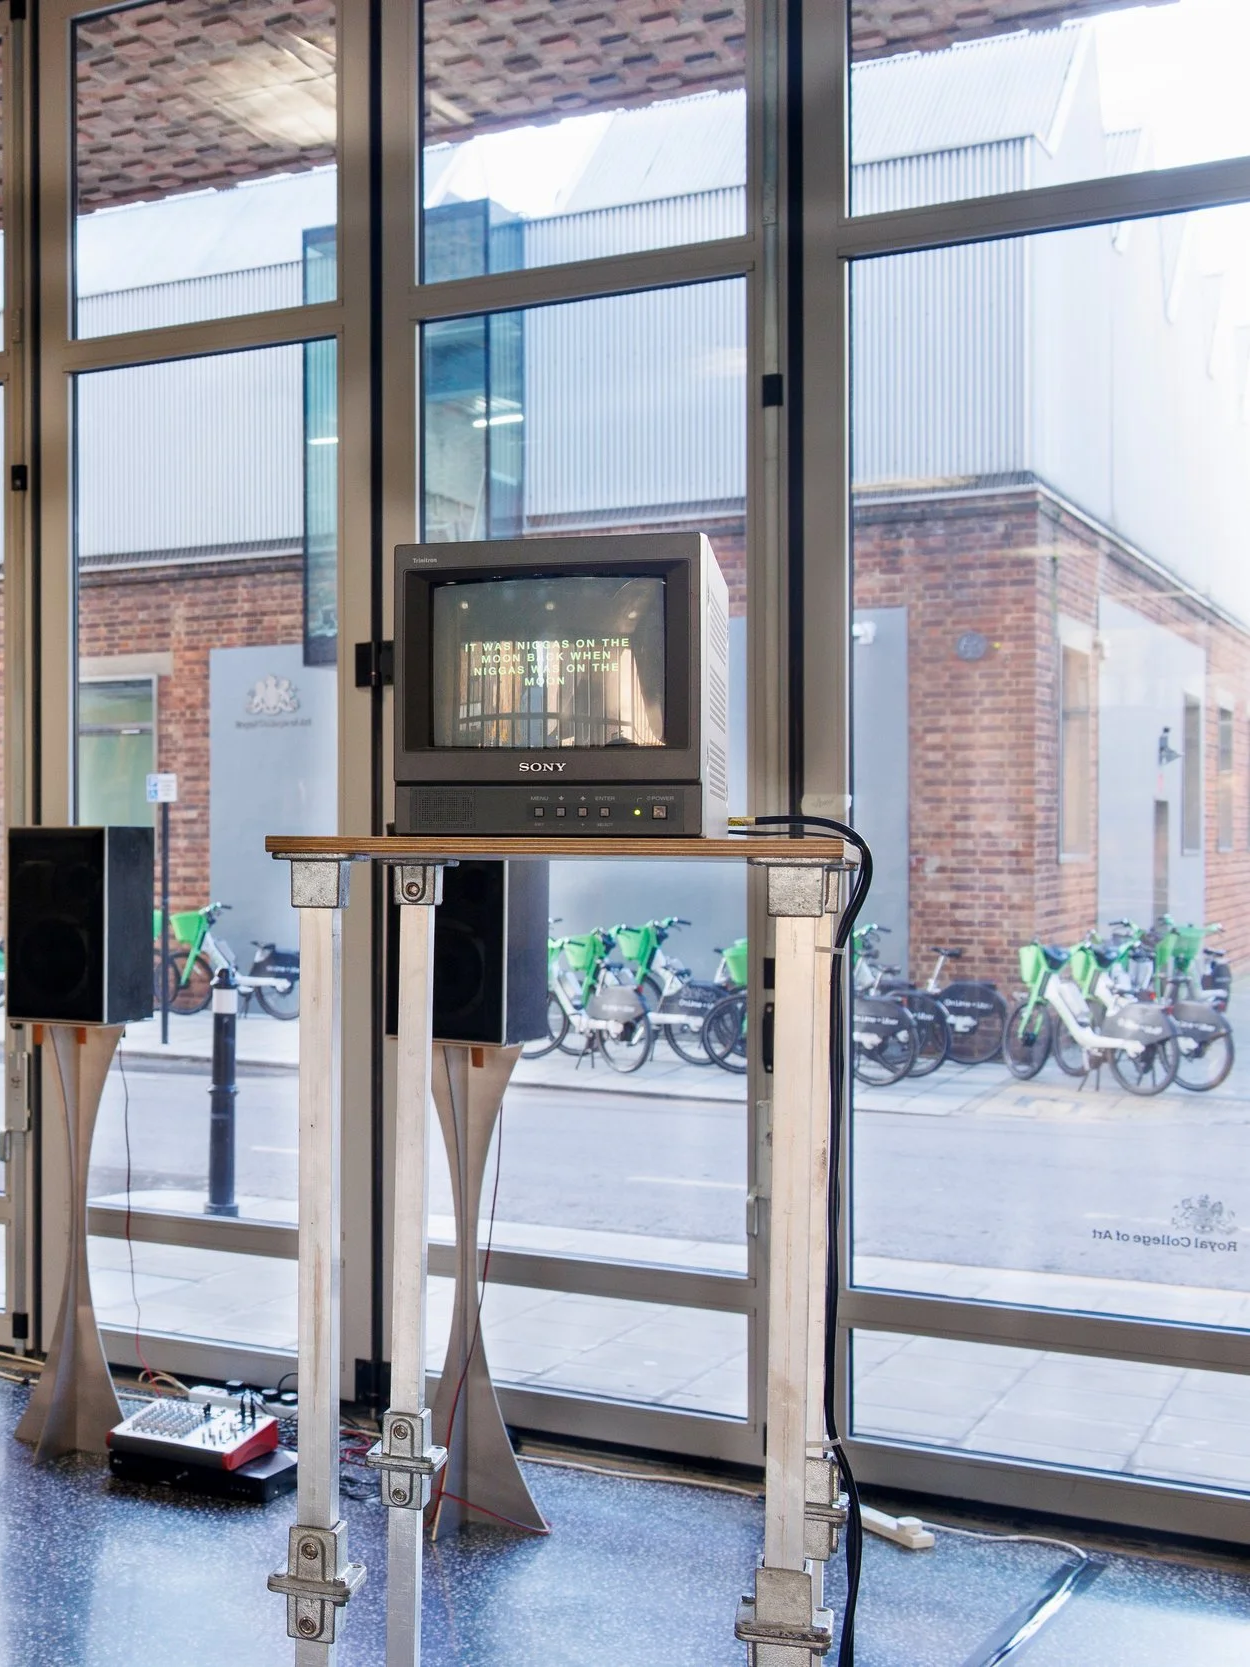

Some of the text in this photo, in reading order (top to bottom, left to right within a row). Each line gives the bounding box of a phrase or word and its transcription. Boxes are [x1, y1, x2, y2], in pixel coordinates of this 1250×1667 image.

[465, 638, 629, 652] IT WAS NIGGAS ON THE
[482, 651, 611, 663] MOON BCK WHEN
[474, 662, 619, 676] NIGGAS WAS ON THE
[525, 677, 566, 687] MOON
[519, 762, 566, 772] SONY
